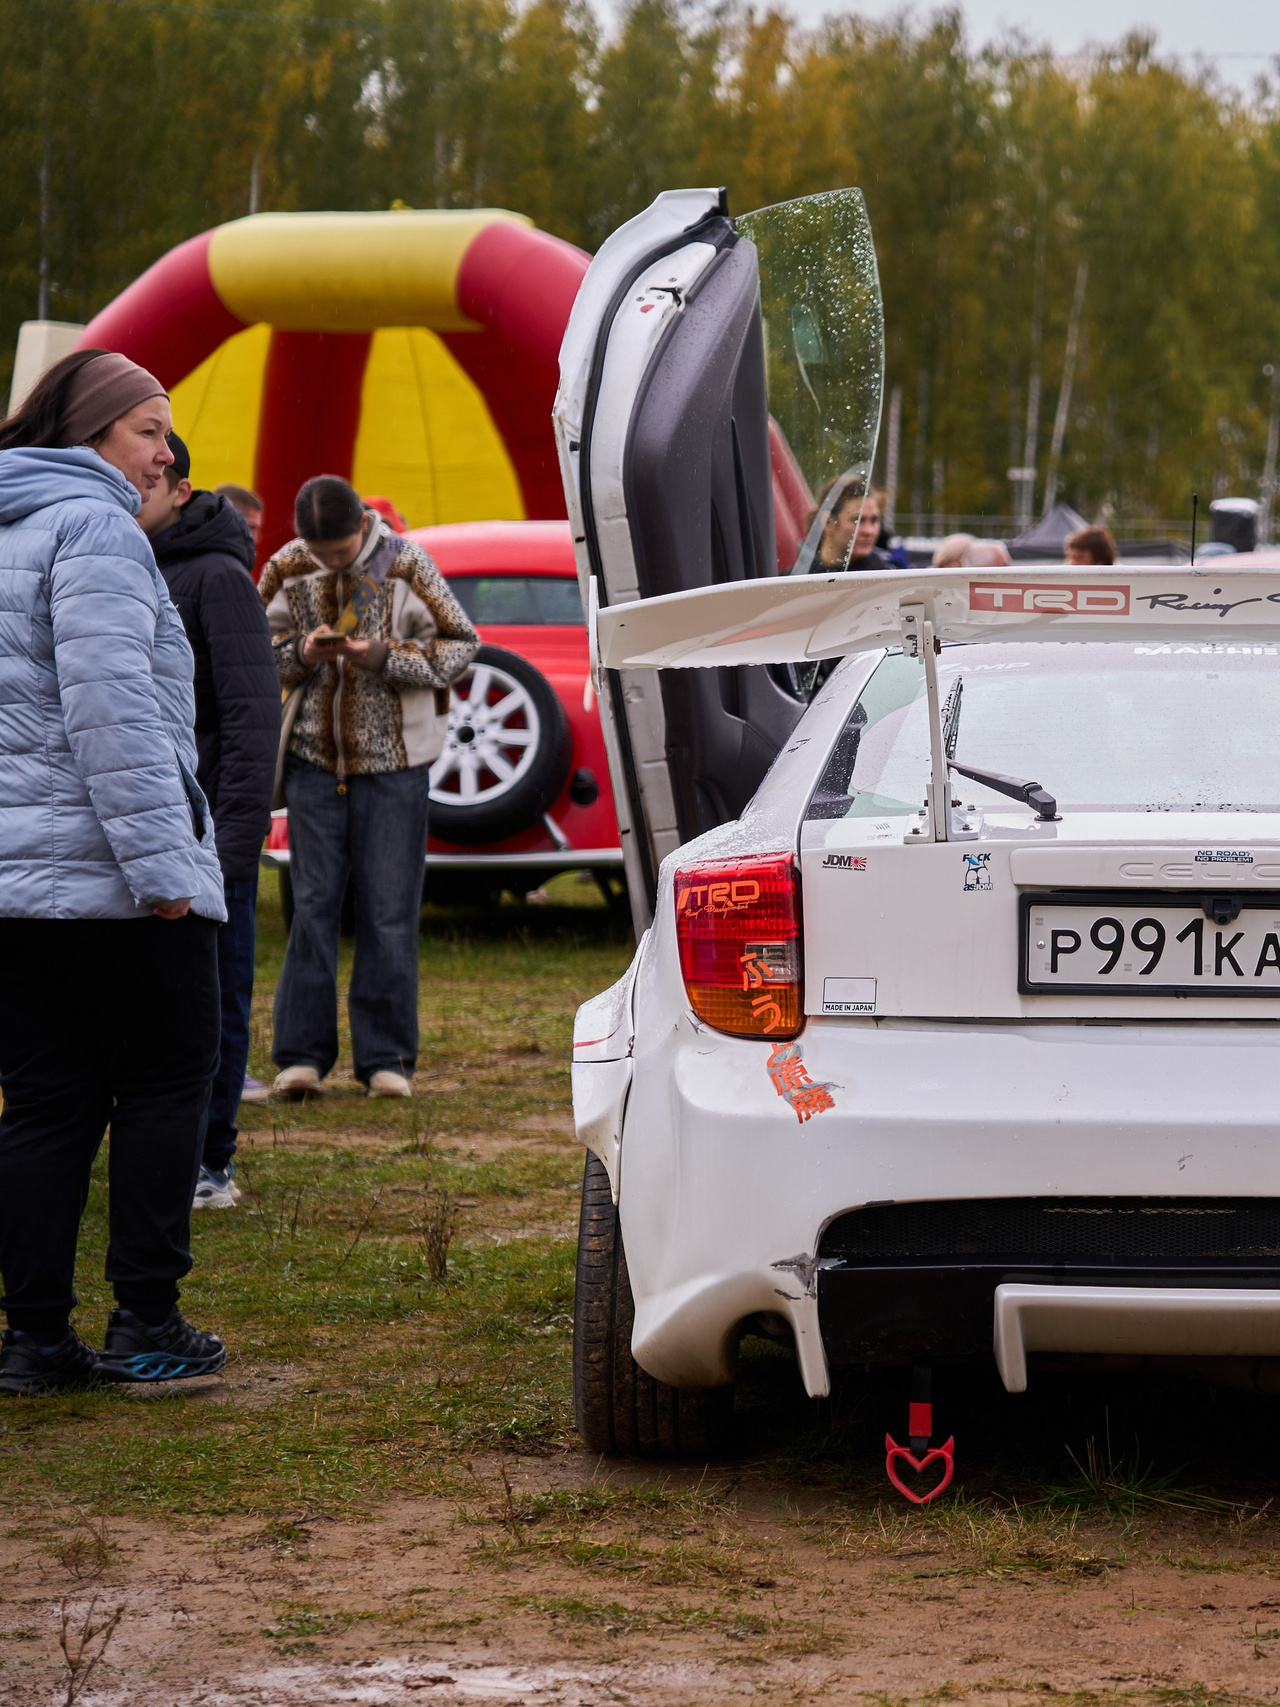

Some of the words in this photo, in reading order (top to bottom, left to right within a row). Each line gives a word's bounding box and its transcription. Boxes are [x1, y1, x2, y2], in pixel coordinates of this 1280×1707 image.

[974, 586, 1127, 612] TRD
[822, 854, 852, 867] JDM
[691, 880, 760, 907] TRD
[851, 1004, 873, 1012] JAPAN
